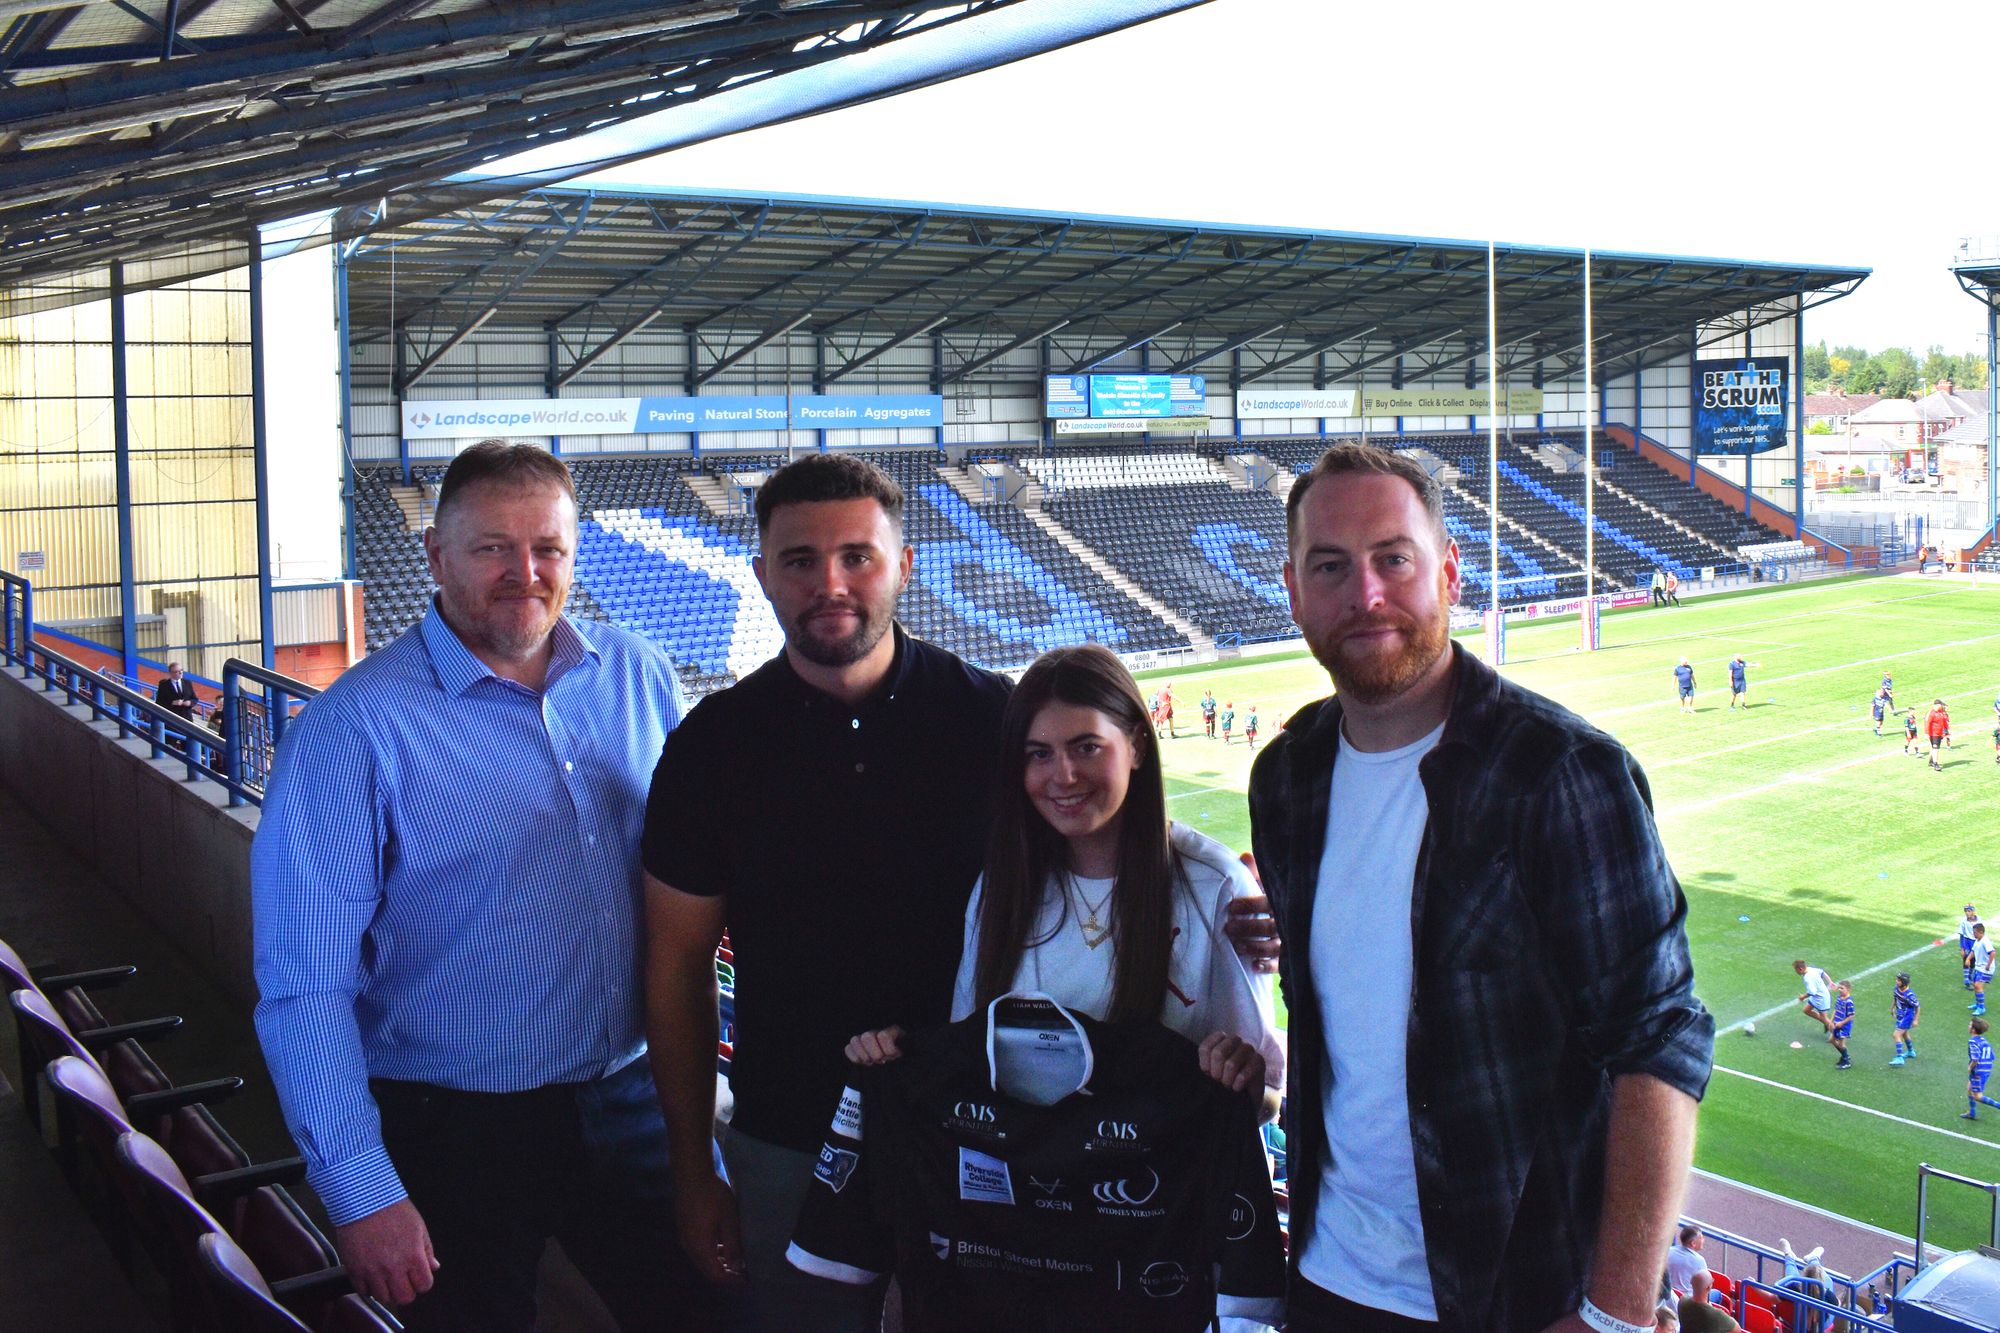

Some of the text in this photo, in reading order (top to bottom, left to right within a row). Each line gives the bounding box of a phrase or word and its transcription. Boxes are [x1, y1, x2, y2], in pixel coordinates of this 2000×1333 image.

[1375, 400, 1388, 409] Buy
[1390, 399, 1412, 407] Online
[1442, 399, 1464, 407] Collect
[1704, 388, 1779, 407] SCRUM
[1253, 399, 1349, 410] LandscapeWorld.co.uk
[434, 409, 628, 427] LandscapeWorld.co.uk
[649, 410, 695, 424] Paving
[705, 408, 752, 421] Natural
[801, 407, 857, 419] Porcelain
[864, 407, 931, 421] Aggregates
[1071, 421, 1143, 430] LandscapeWorld.co.uk
[1544, 600, 1582, 614] SLEEPTIG
[1135, 653, 1150, 661] 0800
[1039, 1033, 1060, 1041] OXEN
[1981, 1046, 1991, 1059] 11
[954, 1101, 996, 1122] CMS
[1097, 1120, 1138, 1140] CMS
[964, 1162, 1005, 1179] Riverside
[968, 1173, 1002, 1185] College
[1035, 1200, 1073, 1211] OXEN
[1097, 1206, 1130, 1216] WIDNES
[958, 1241, 1094, 1273] Bristol Street Motors
[1139, 1273, 1190, 1286] NIAN
[1593, 1311, 1615, 1328] dcbl
